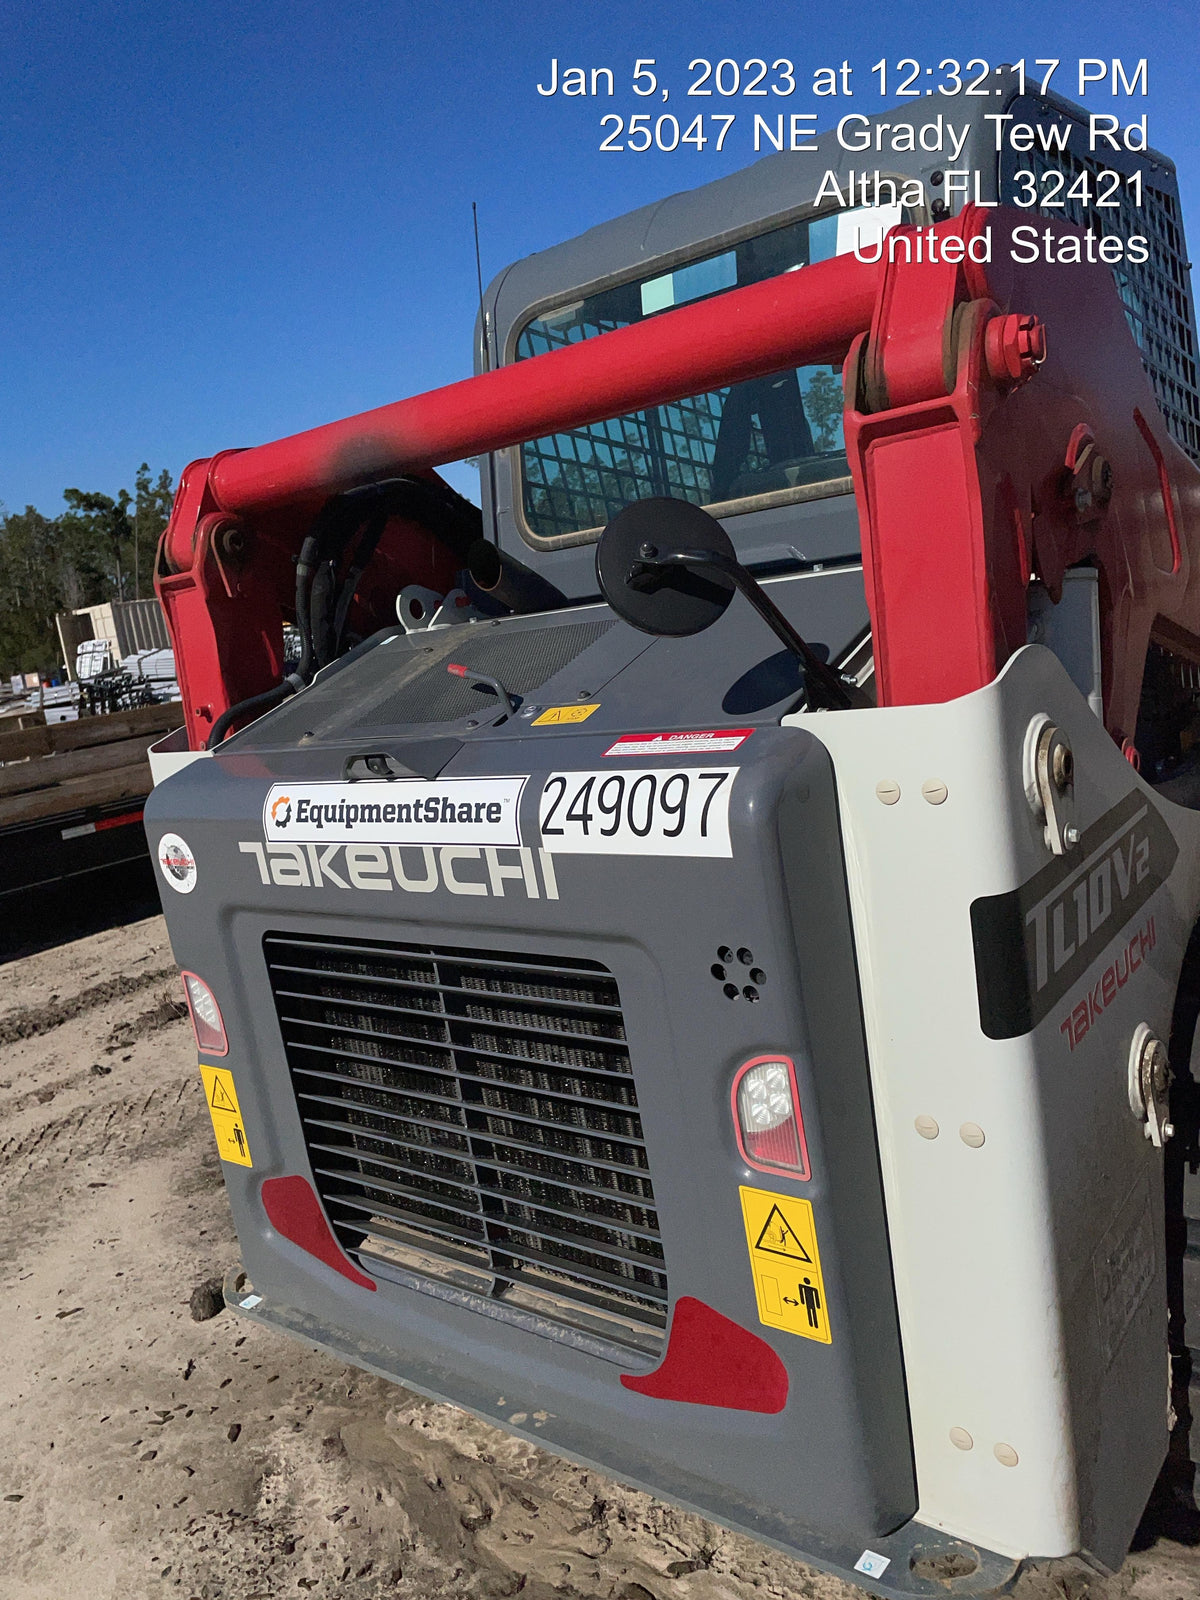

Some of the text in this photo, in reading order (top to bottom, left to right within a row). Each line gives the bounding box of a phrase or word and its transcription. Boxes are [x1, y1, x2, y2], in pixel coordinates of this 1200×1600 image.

[668, 732, 716, 741] DANGER
[295, 796, 502, 829] EquipmentShare
[541, 772, 730, 838] 249097
[1025, 803, 1150, 993] TL10V2
